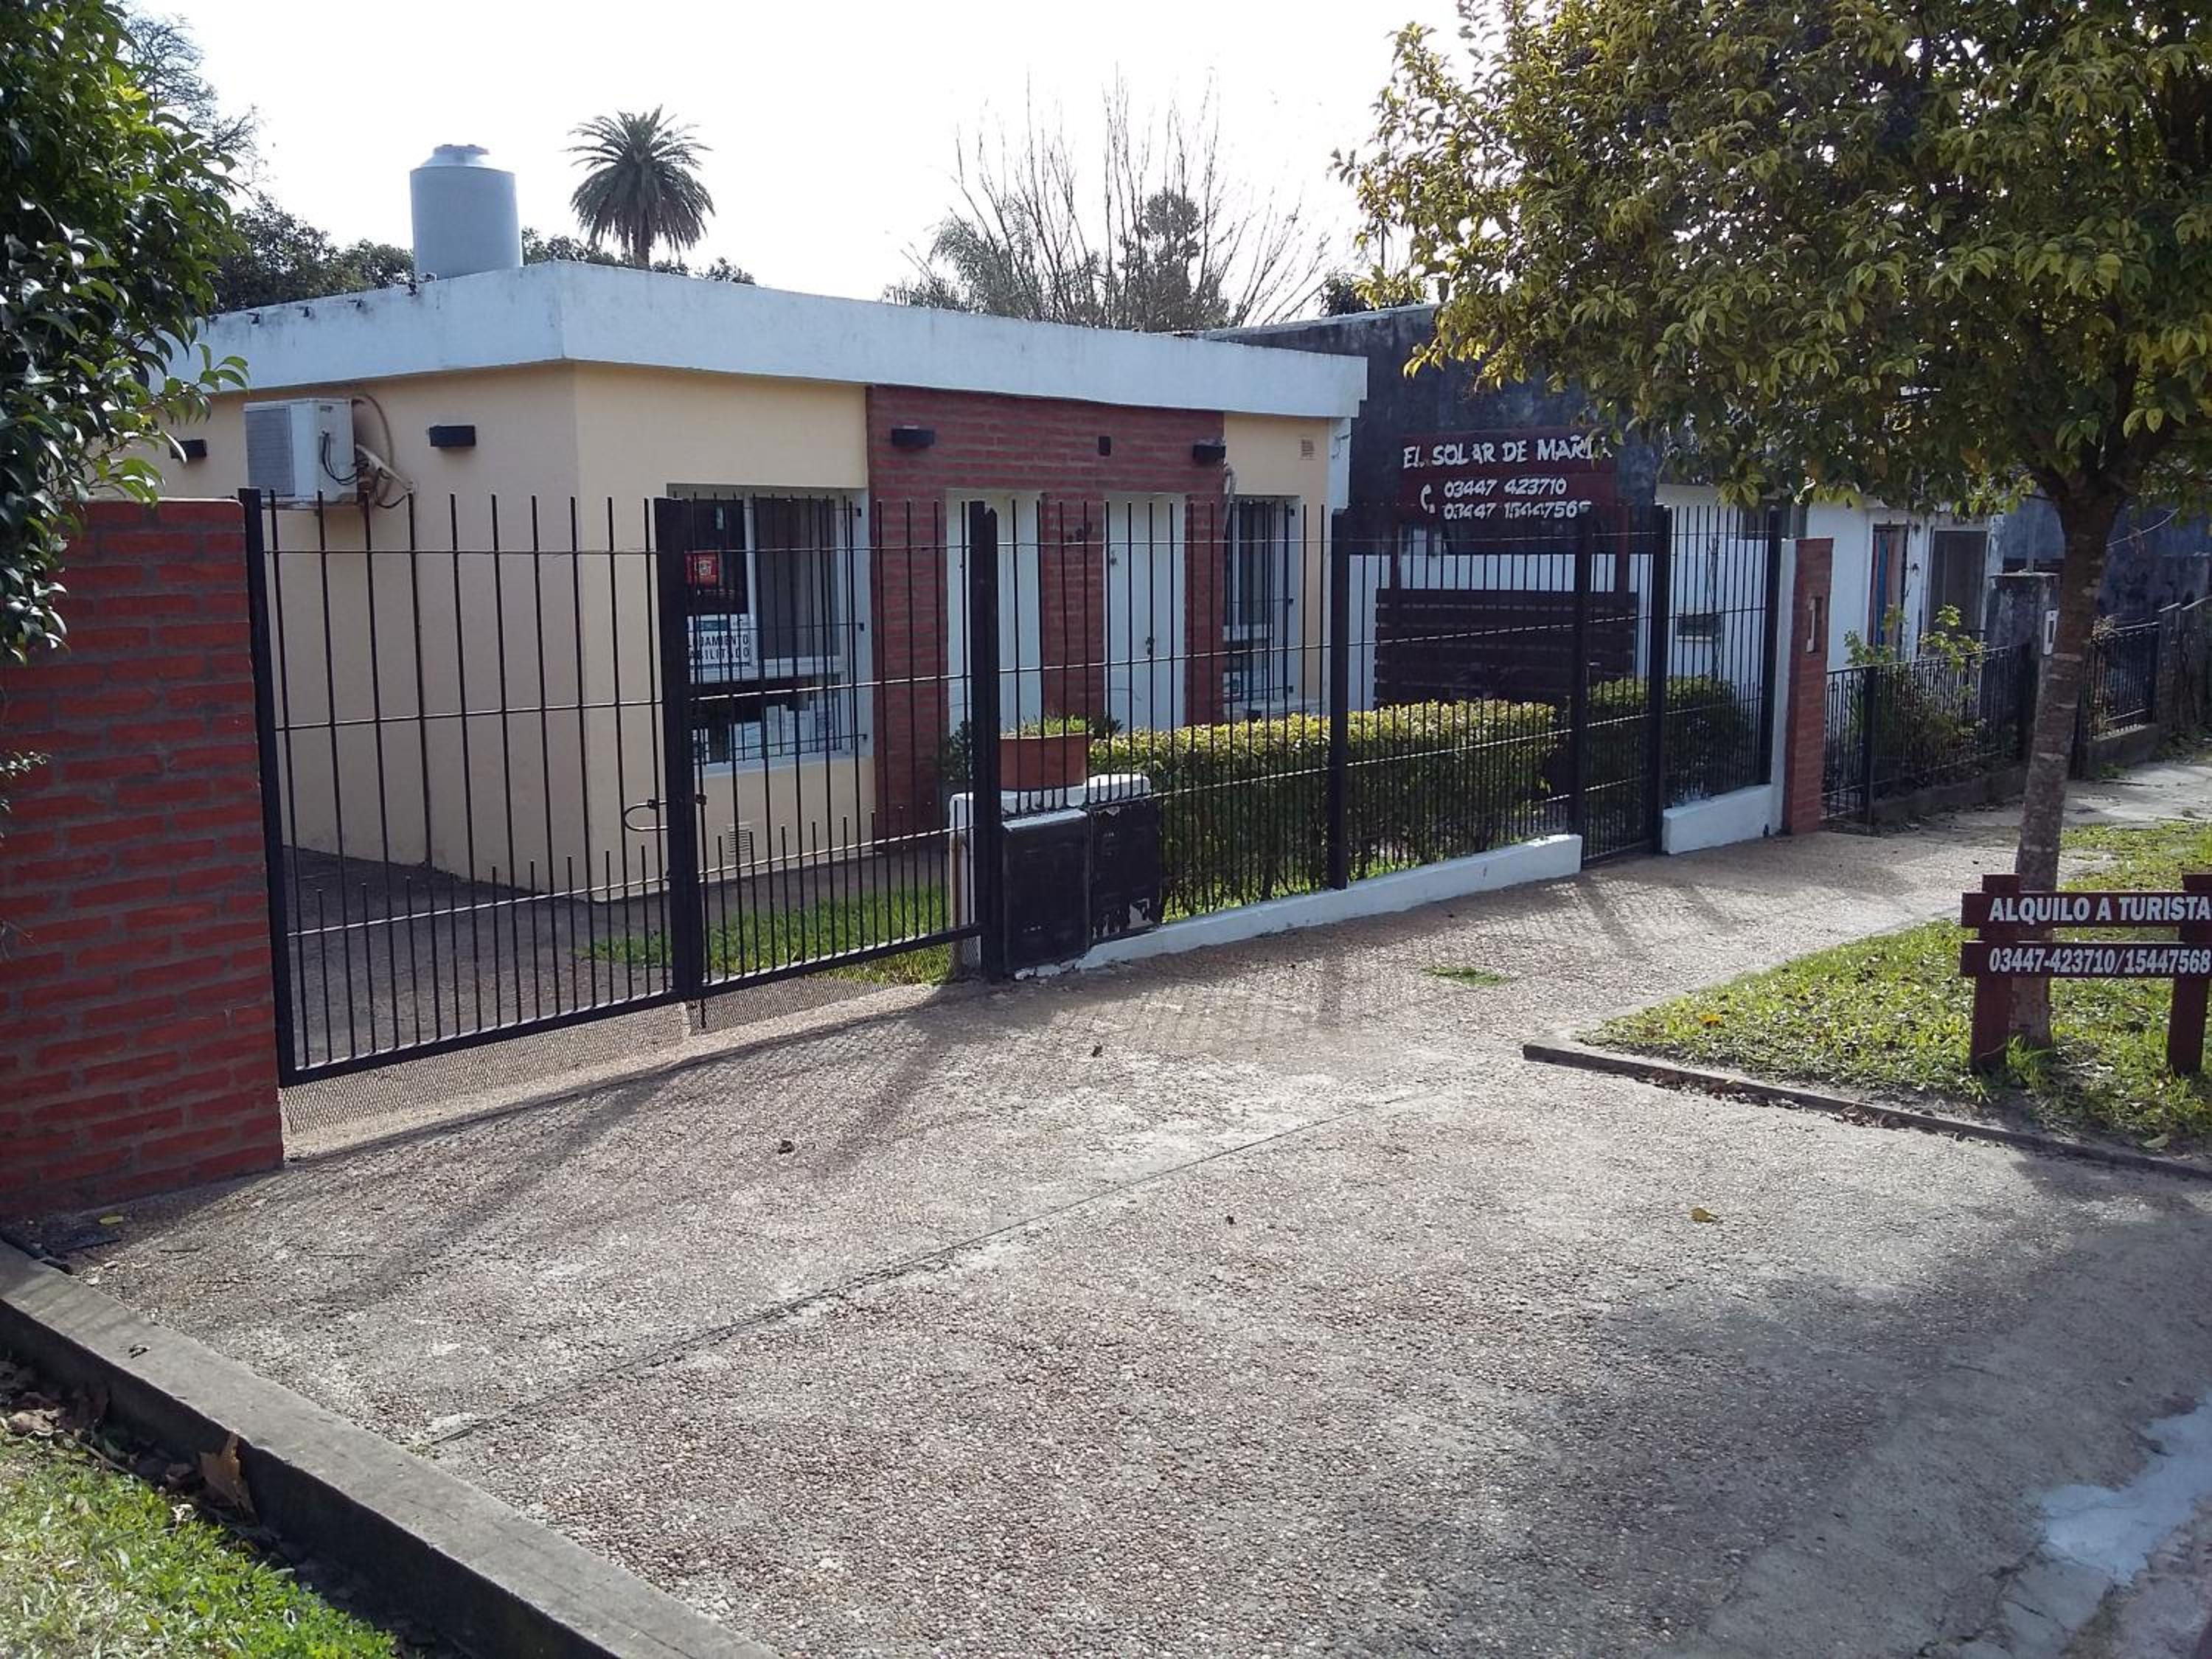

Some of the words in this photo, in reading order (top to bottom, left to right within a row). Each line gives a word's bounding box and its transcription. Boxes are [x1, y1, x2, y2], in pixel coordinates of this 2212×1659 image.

[1403, 445, 1425, 468] EL
[1431, 442, 1496, 465] SOLAR
[1502, 440, 1527, 462] DE
[1444, 480, 1498, 498] 03447
[1504, 478, 1566, 495] 423710
[1443, 503, 1497, 520] 03447
[1989, 897, 2090, 925] ALQUILO
[2096, 897, 2112, 921] A
[2118, 896, 2211, 921] TURISTA
[1989, 947, 2211, 974] 03447-423710/15447568
